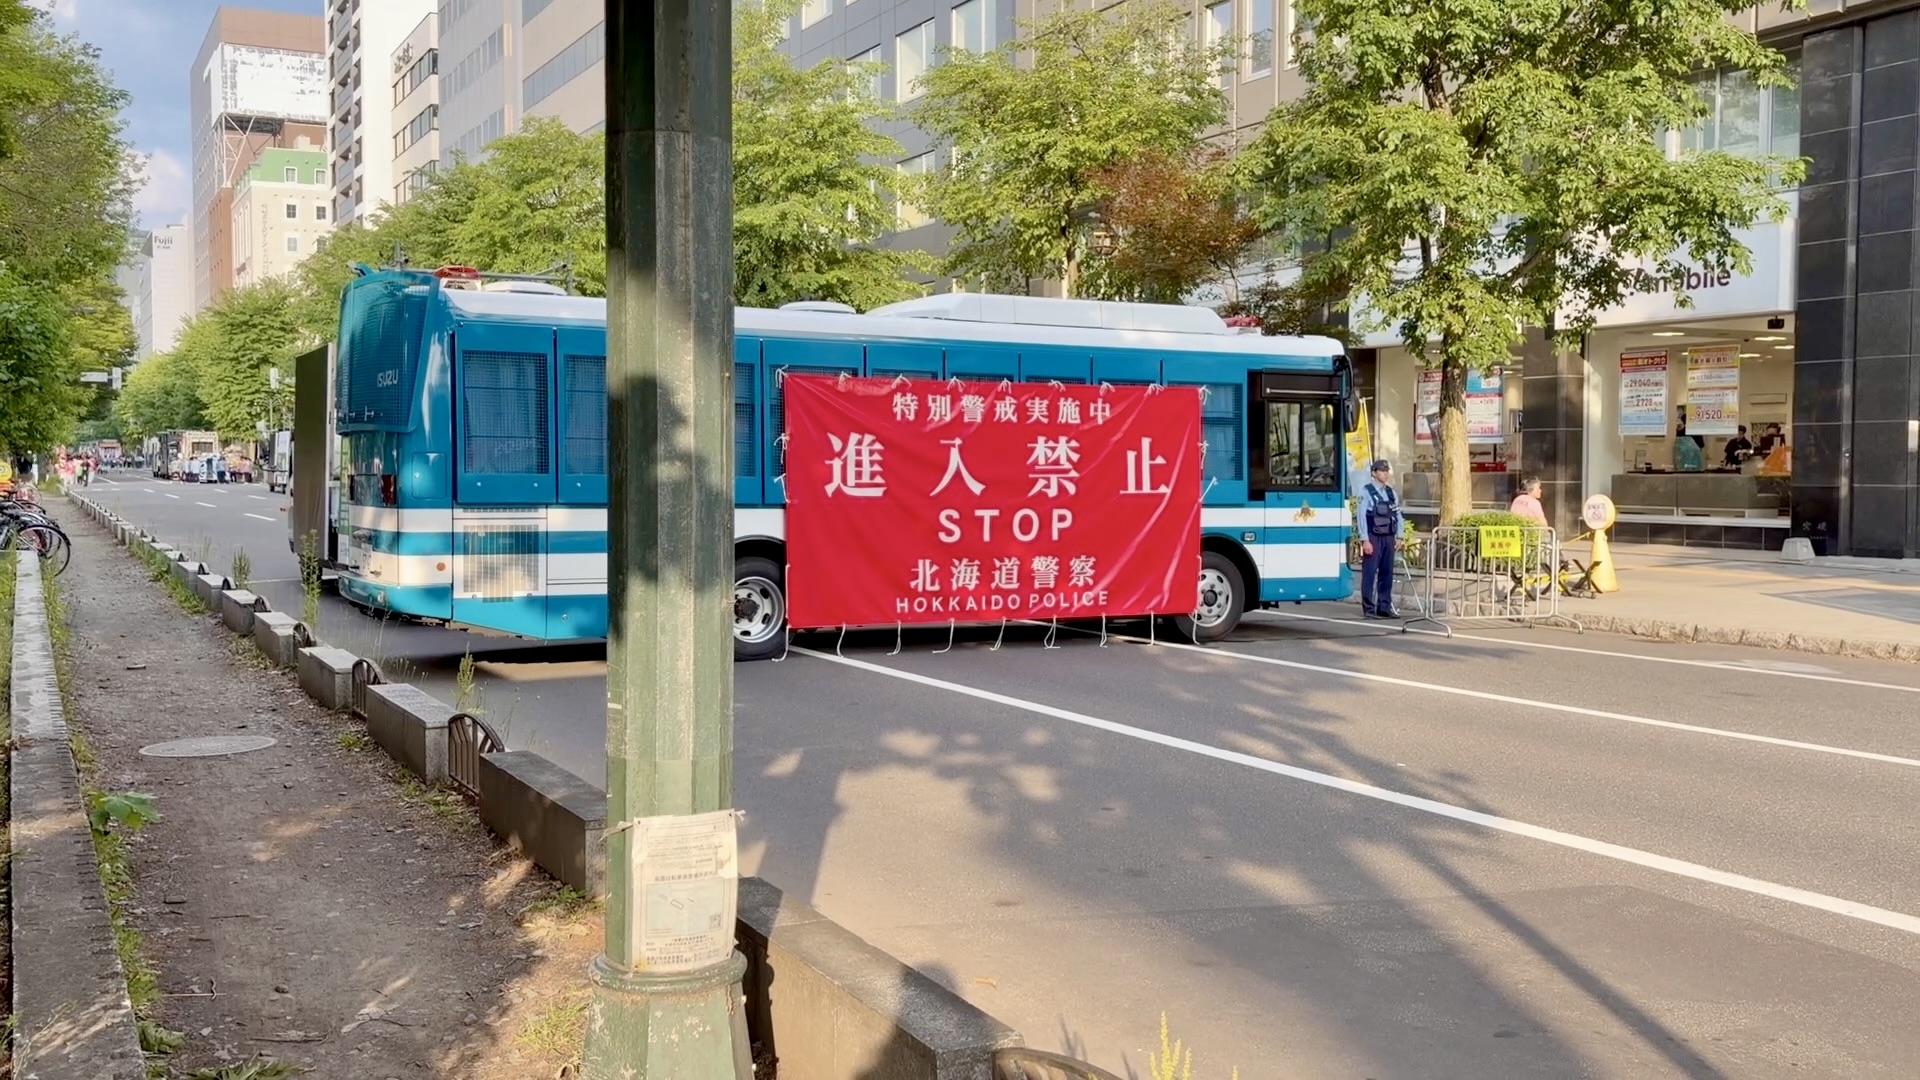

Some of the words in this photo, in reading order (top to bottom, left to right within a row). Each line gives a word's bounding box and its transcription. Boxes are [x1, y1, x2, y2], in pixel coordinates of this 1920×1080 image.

[154, 236, 173, 245] Fujii
[377, 369, 399, 387] ISUZU
[893, 393, 1111, 425] 特別警戒実施中
[824, 431, 1170, 498] 進入禁止
[938, 508, 1074, 543] STOP
[1485, 528, 1516, 539] 特別警戒
[909, 555, 1098, 593] 北海道警察
[896, 593, 1020, 614] HOKKAIDO
[1029, 590, 1109, 609] POLICE
